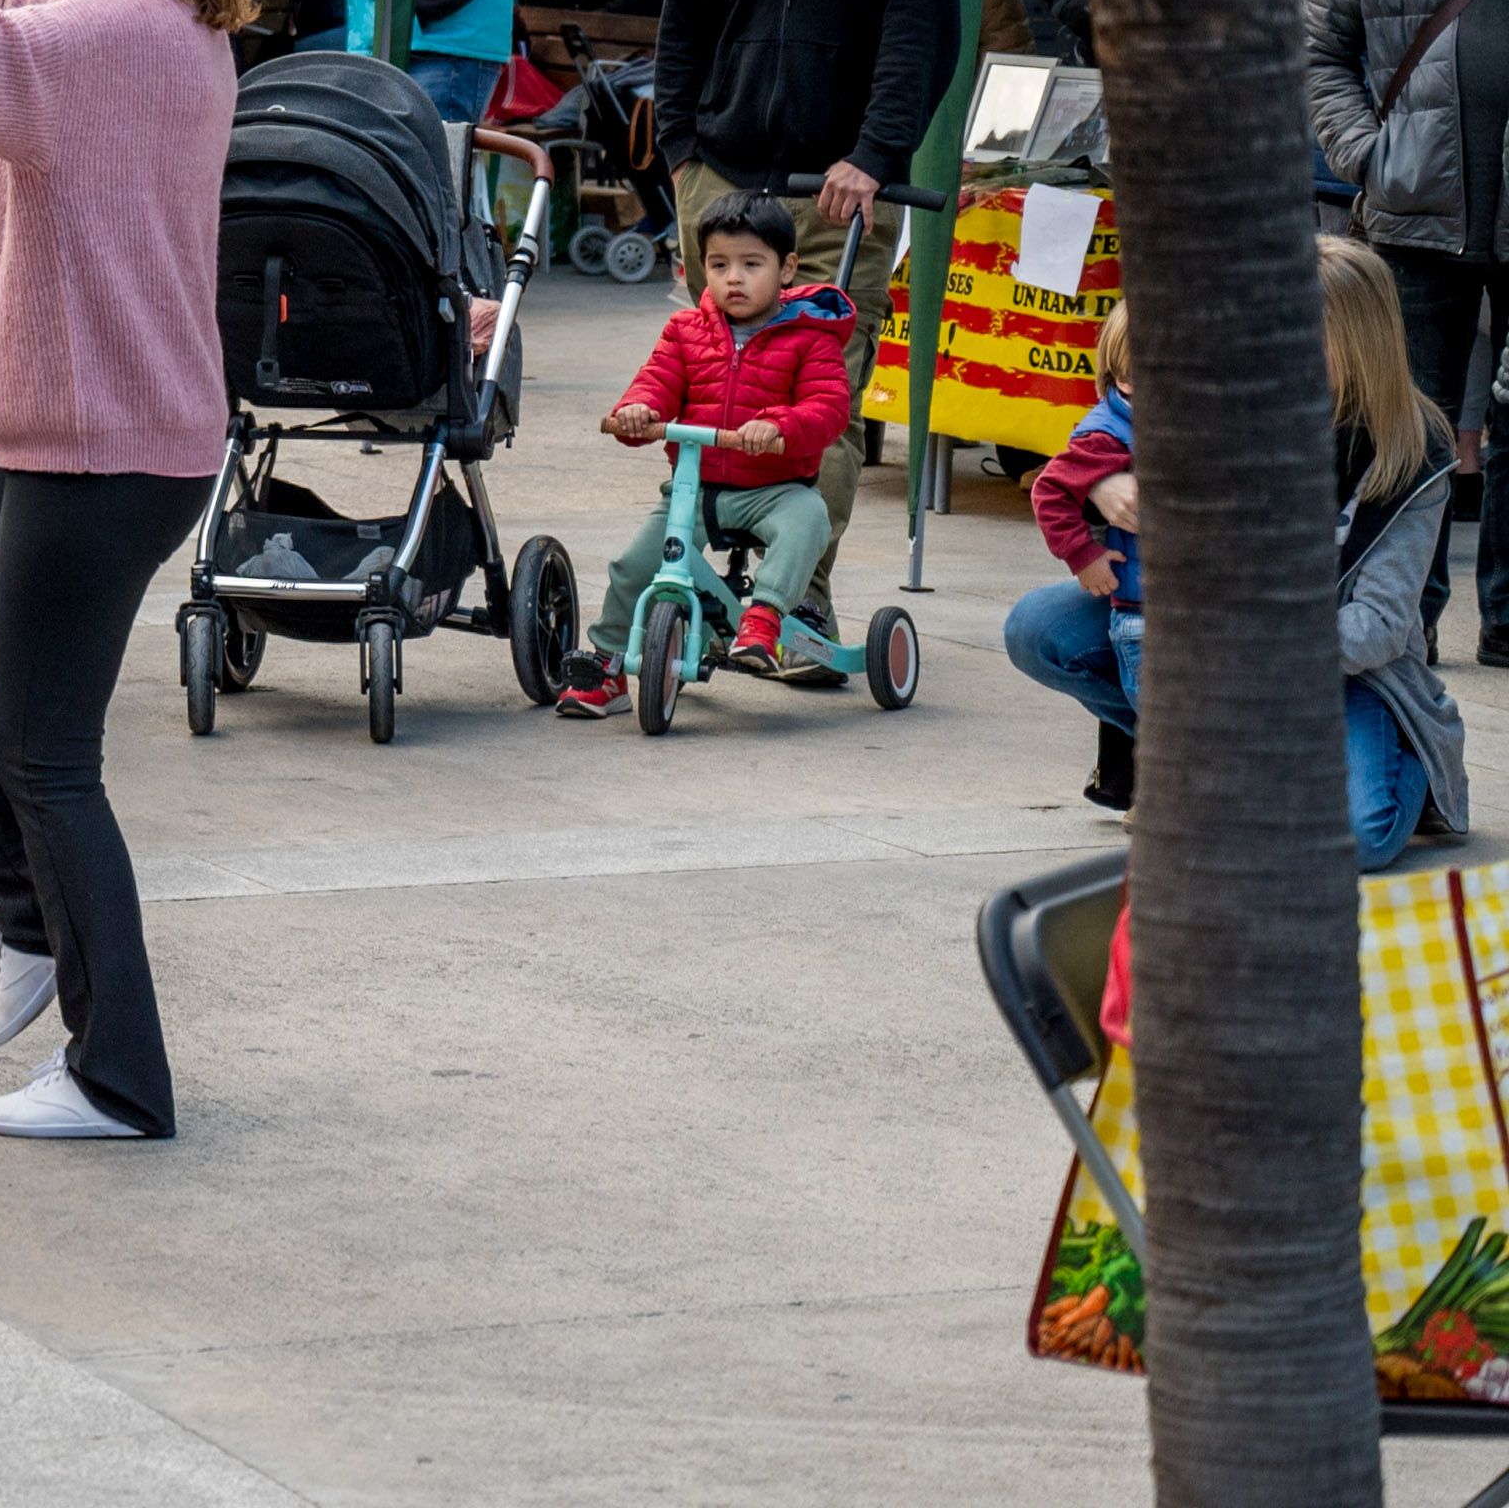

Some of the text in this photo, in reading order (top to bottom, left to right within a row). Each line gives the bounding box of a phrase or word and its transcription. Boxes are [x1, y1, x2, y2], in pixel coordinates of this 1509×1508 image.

[1013, 284, 1038, 308] UN
[1039, 289, 1088, 316] RAM
[1028, 346, 1096, 375] CADA
